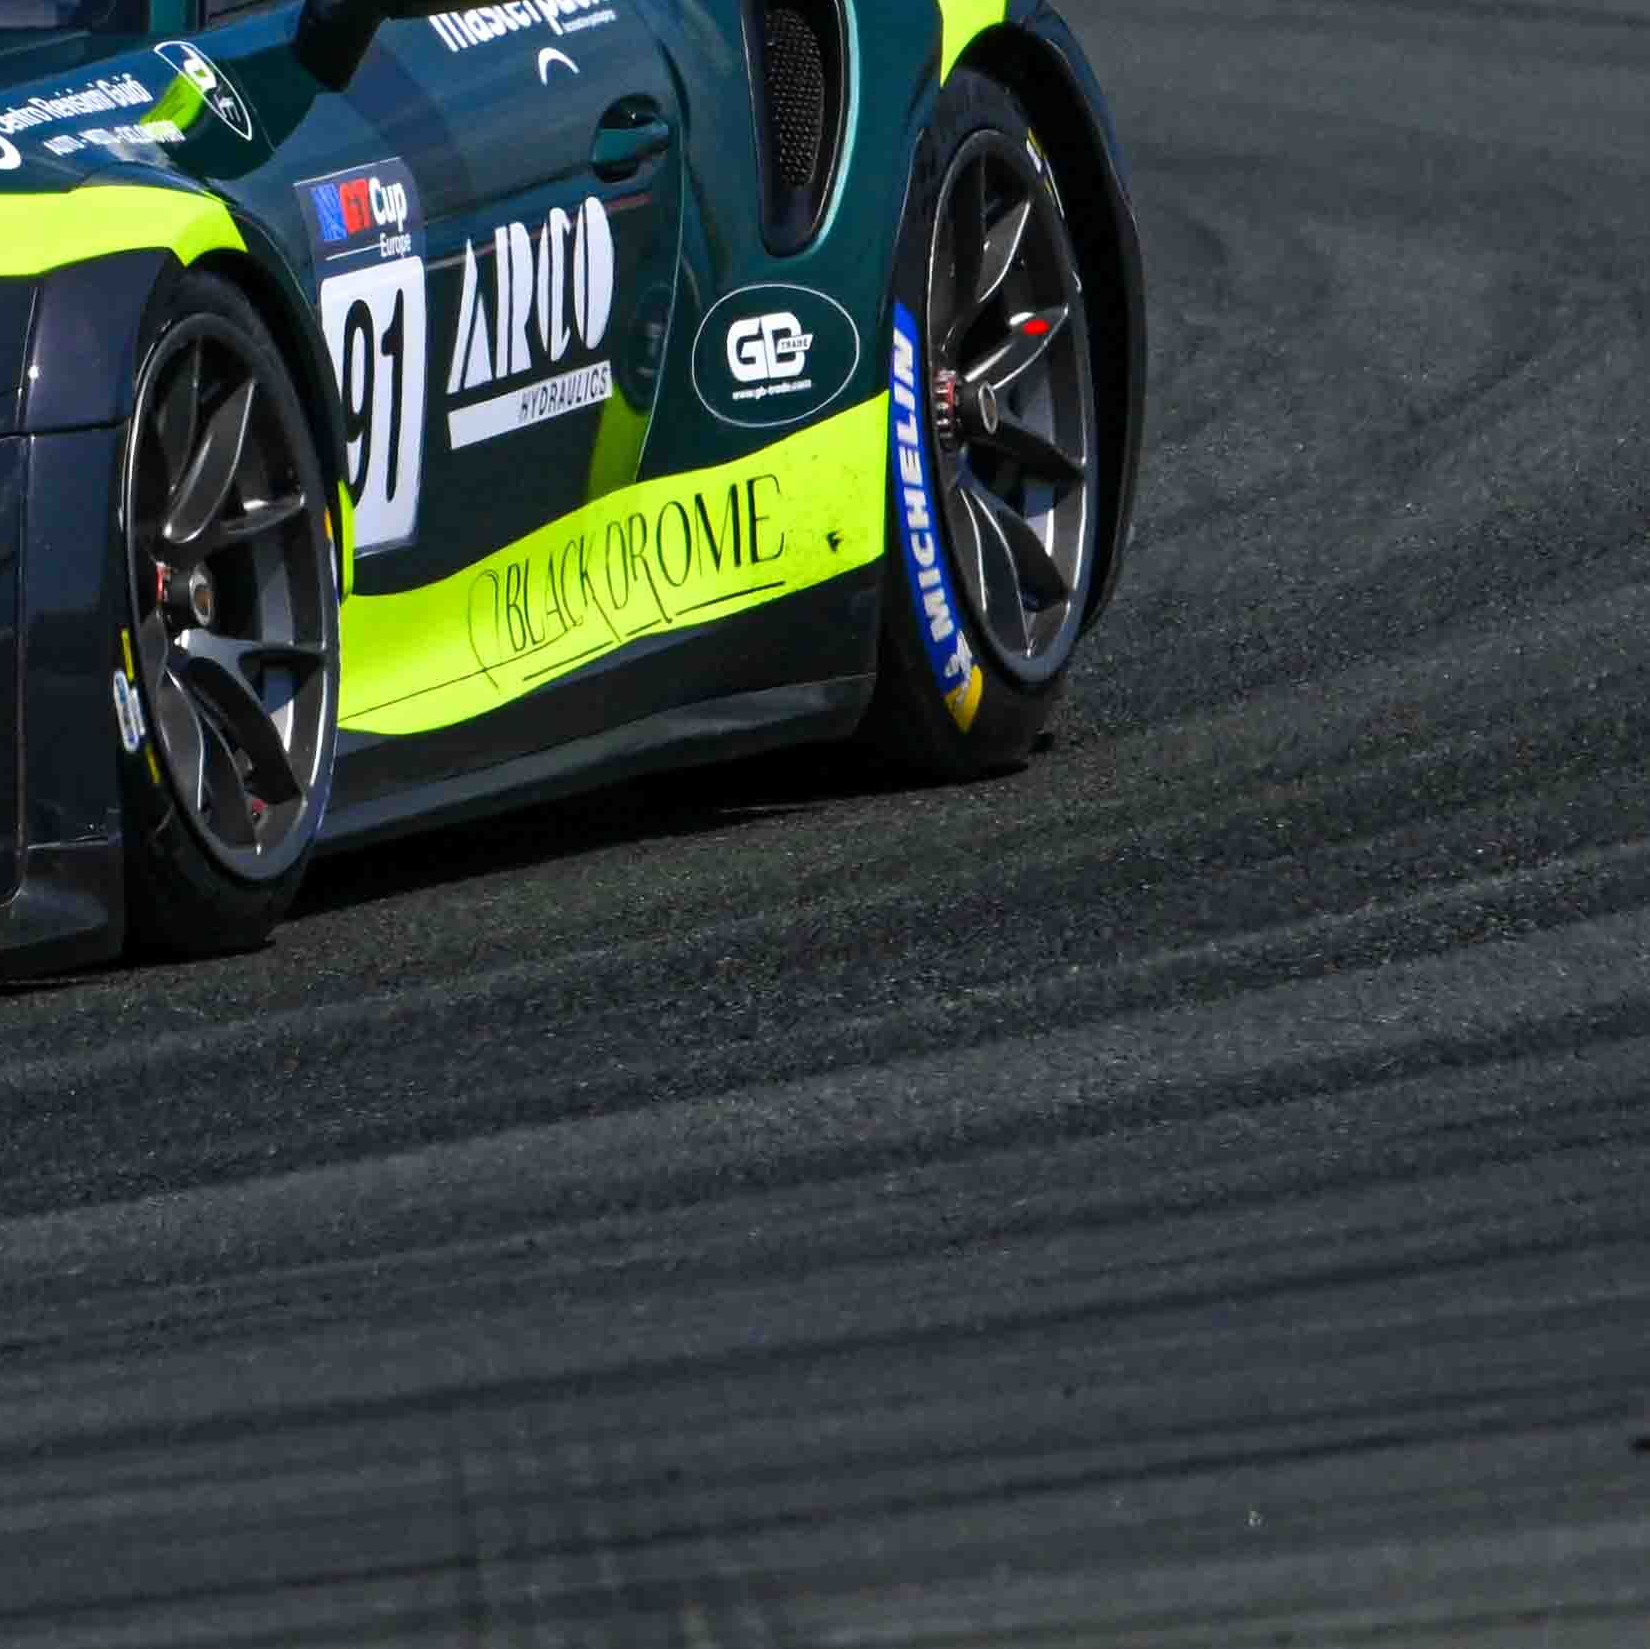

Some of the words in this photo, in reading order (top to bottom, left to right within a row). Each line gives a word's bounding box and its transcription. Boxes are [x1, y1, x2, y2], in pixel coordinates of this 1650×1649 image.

[369, 176, 408, 232] Cup
[447, 196, 615, 394] ARCO
[727, 312, 806, 383] GB
[342, 288, 404, 509] 91
[518, 365, 609, 423] HYDRAULICS
[892, 327, 954, 643] MICHELIN
